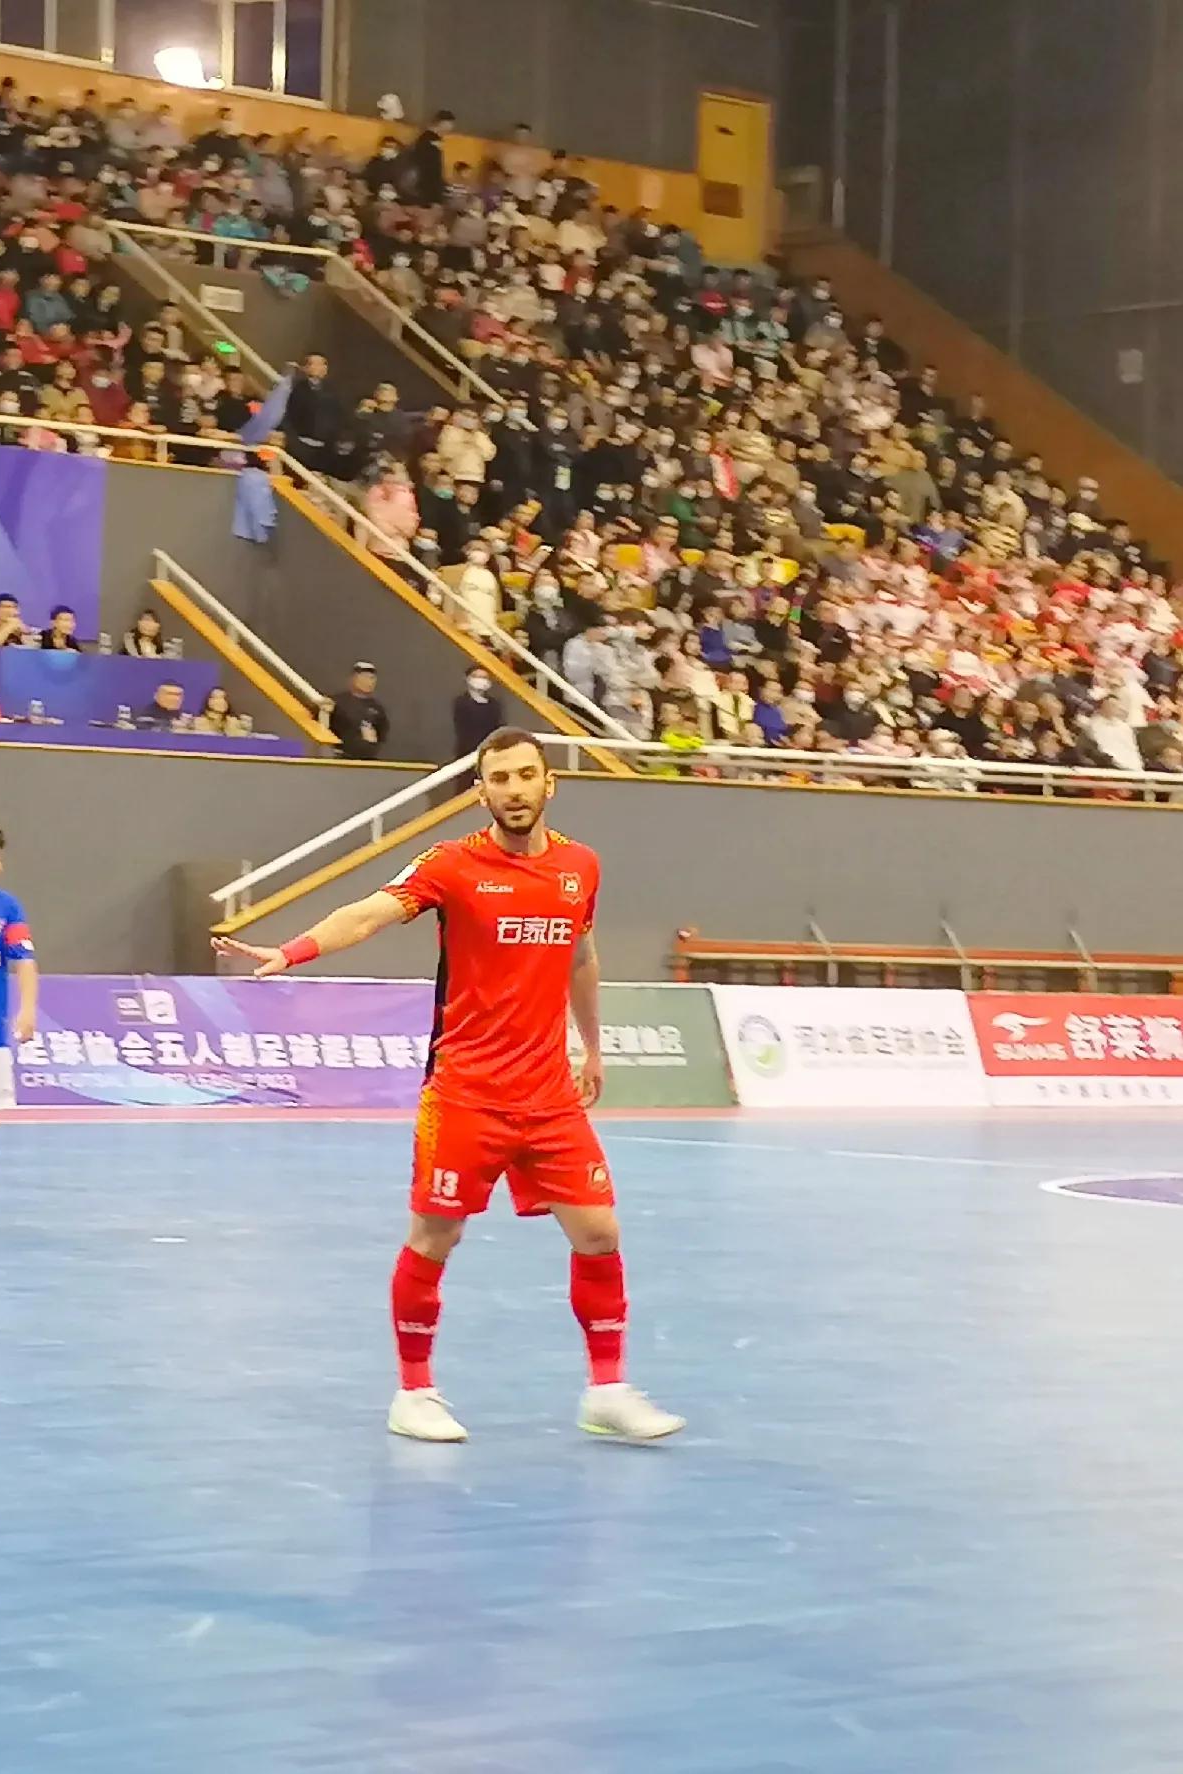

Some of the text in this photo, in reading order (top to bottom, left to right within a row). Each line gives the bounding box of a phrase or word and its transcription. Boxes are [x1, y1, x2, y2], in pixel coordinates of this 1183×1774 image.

[496, 916, 573, 945] 石家庄
[432, 1168, 459, 1197] 13
